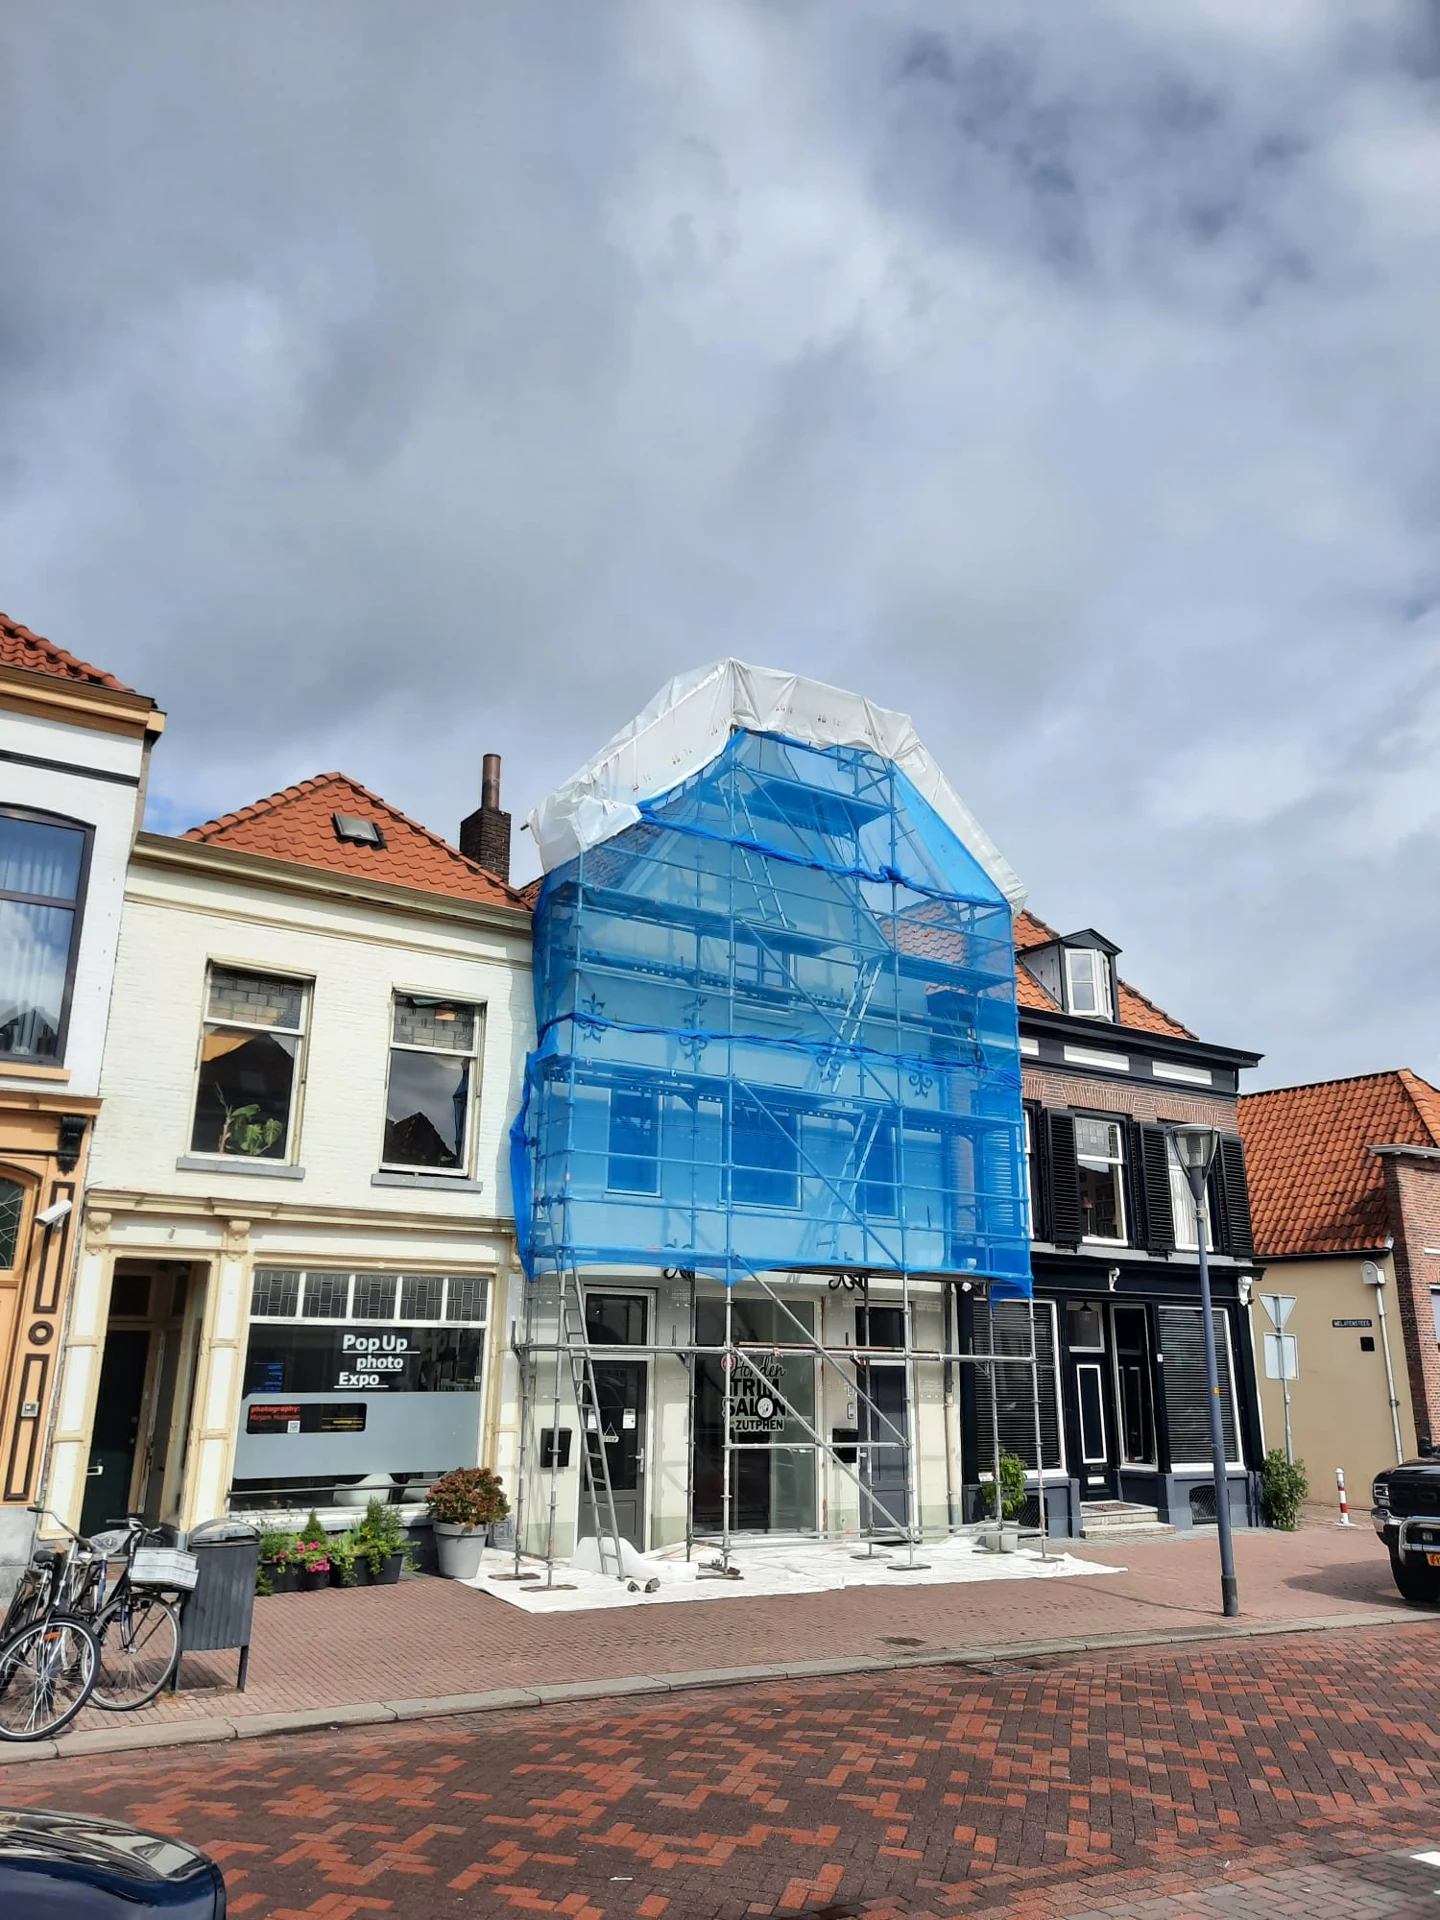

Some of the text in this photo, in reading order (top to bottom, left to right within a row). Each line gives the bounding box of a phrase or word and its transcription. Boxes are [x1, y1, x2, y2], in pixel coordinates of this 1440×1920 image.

[356, 1355, 404, 1371] photo
[338, 1371, 380, 1388] Expo
[736, 1420, 783, 1430] ZUTPHEN
